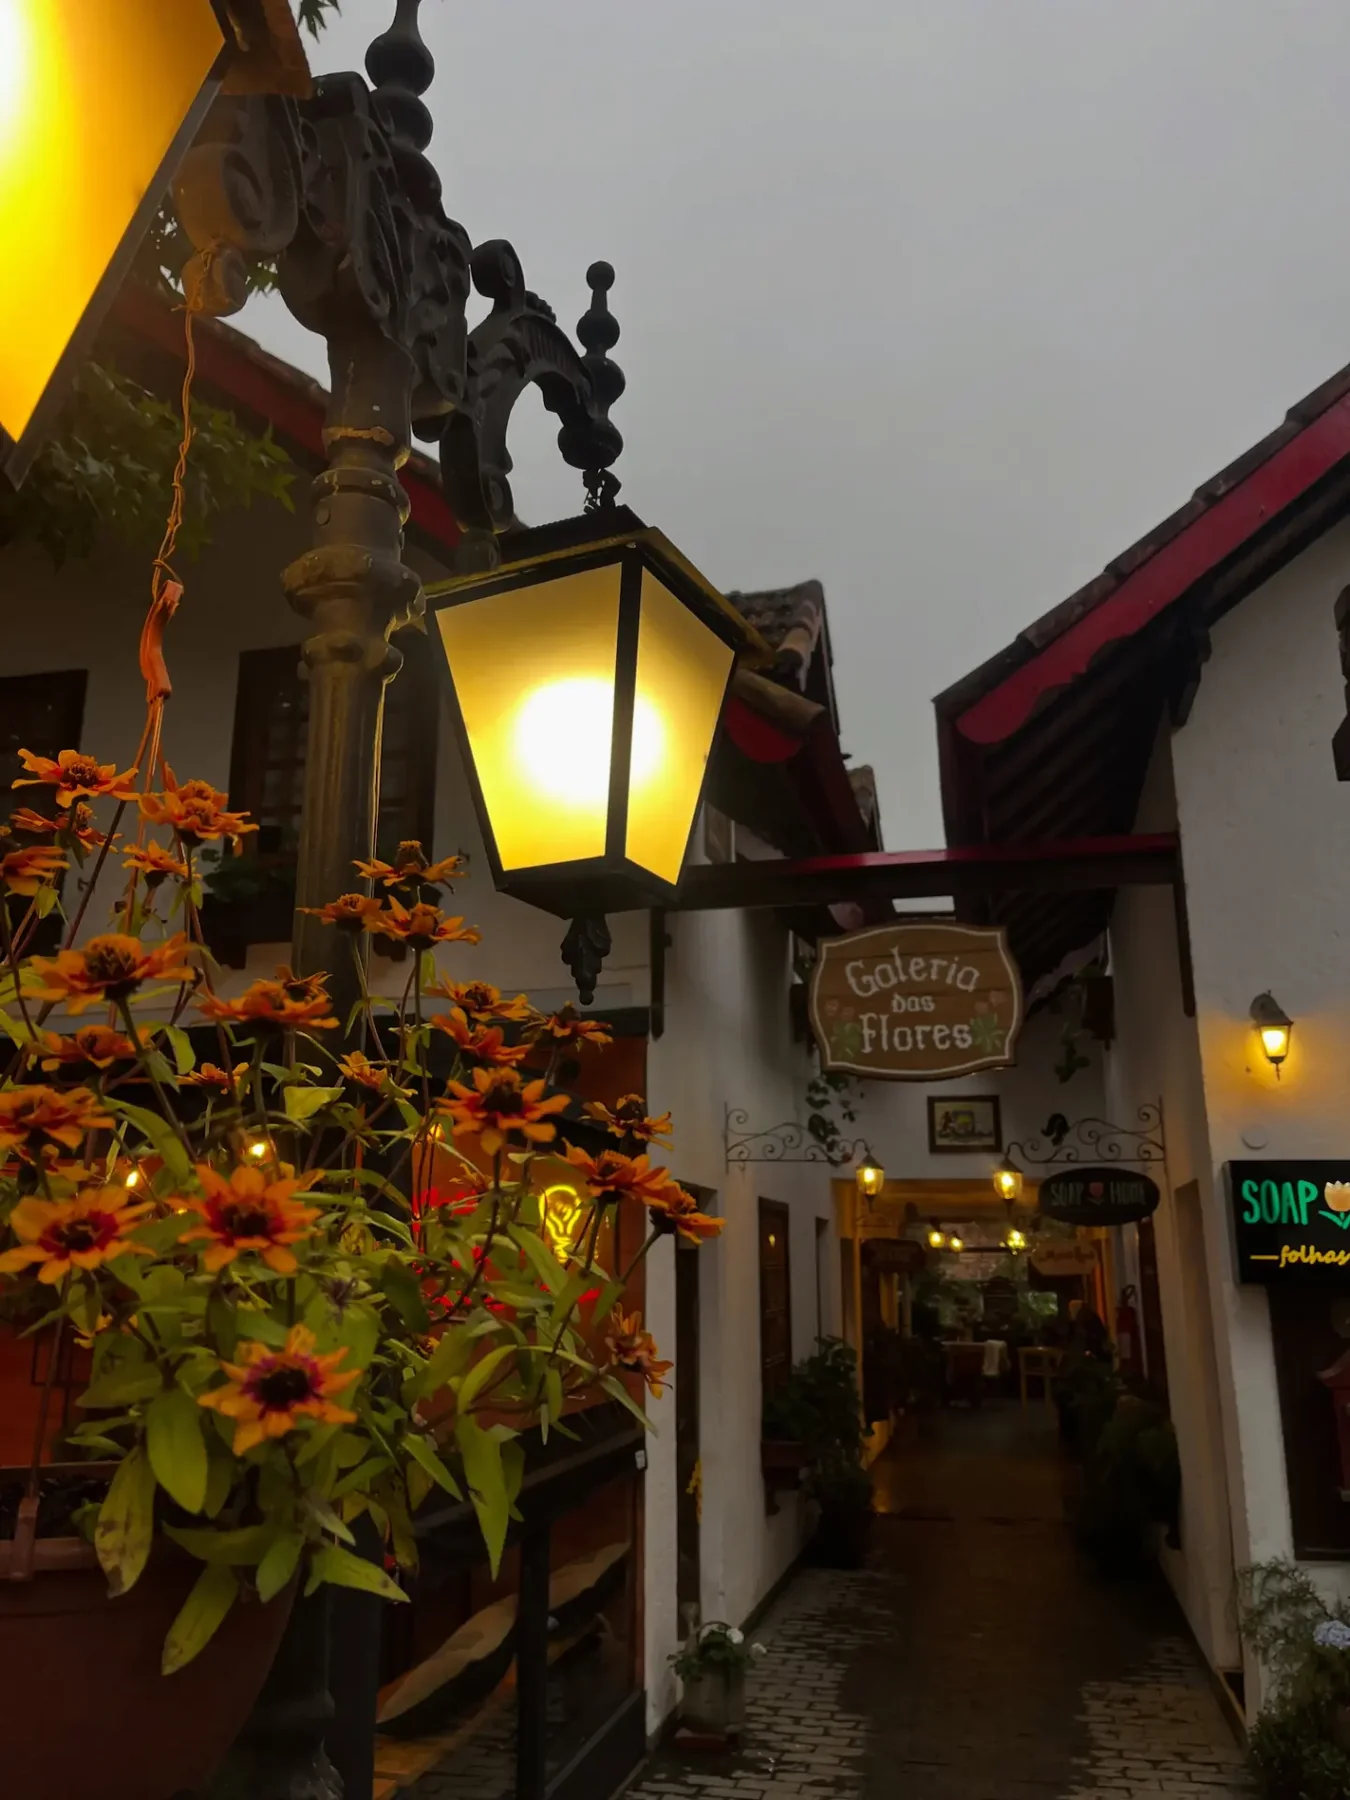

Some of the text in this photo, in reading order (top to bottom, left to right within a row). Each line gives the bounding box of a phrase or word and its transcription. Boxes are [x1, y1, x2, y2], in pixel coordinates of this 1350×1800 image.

[845, 946, 980, 997] Galeria
[859, 1012, 973, 1053] Flores
[1241, 1179, 1318, 1225] SOAP
[1279, 1244, 1350, 1268] folhas
